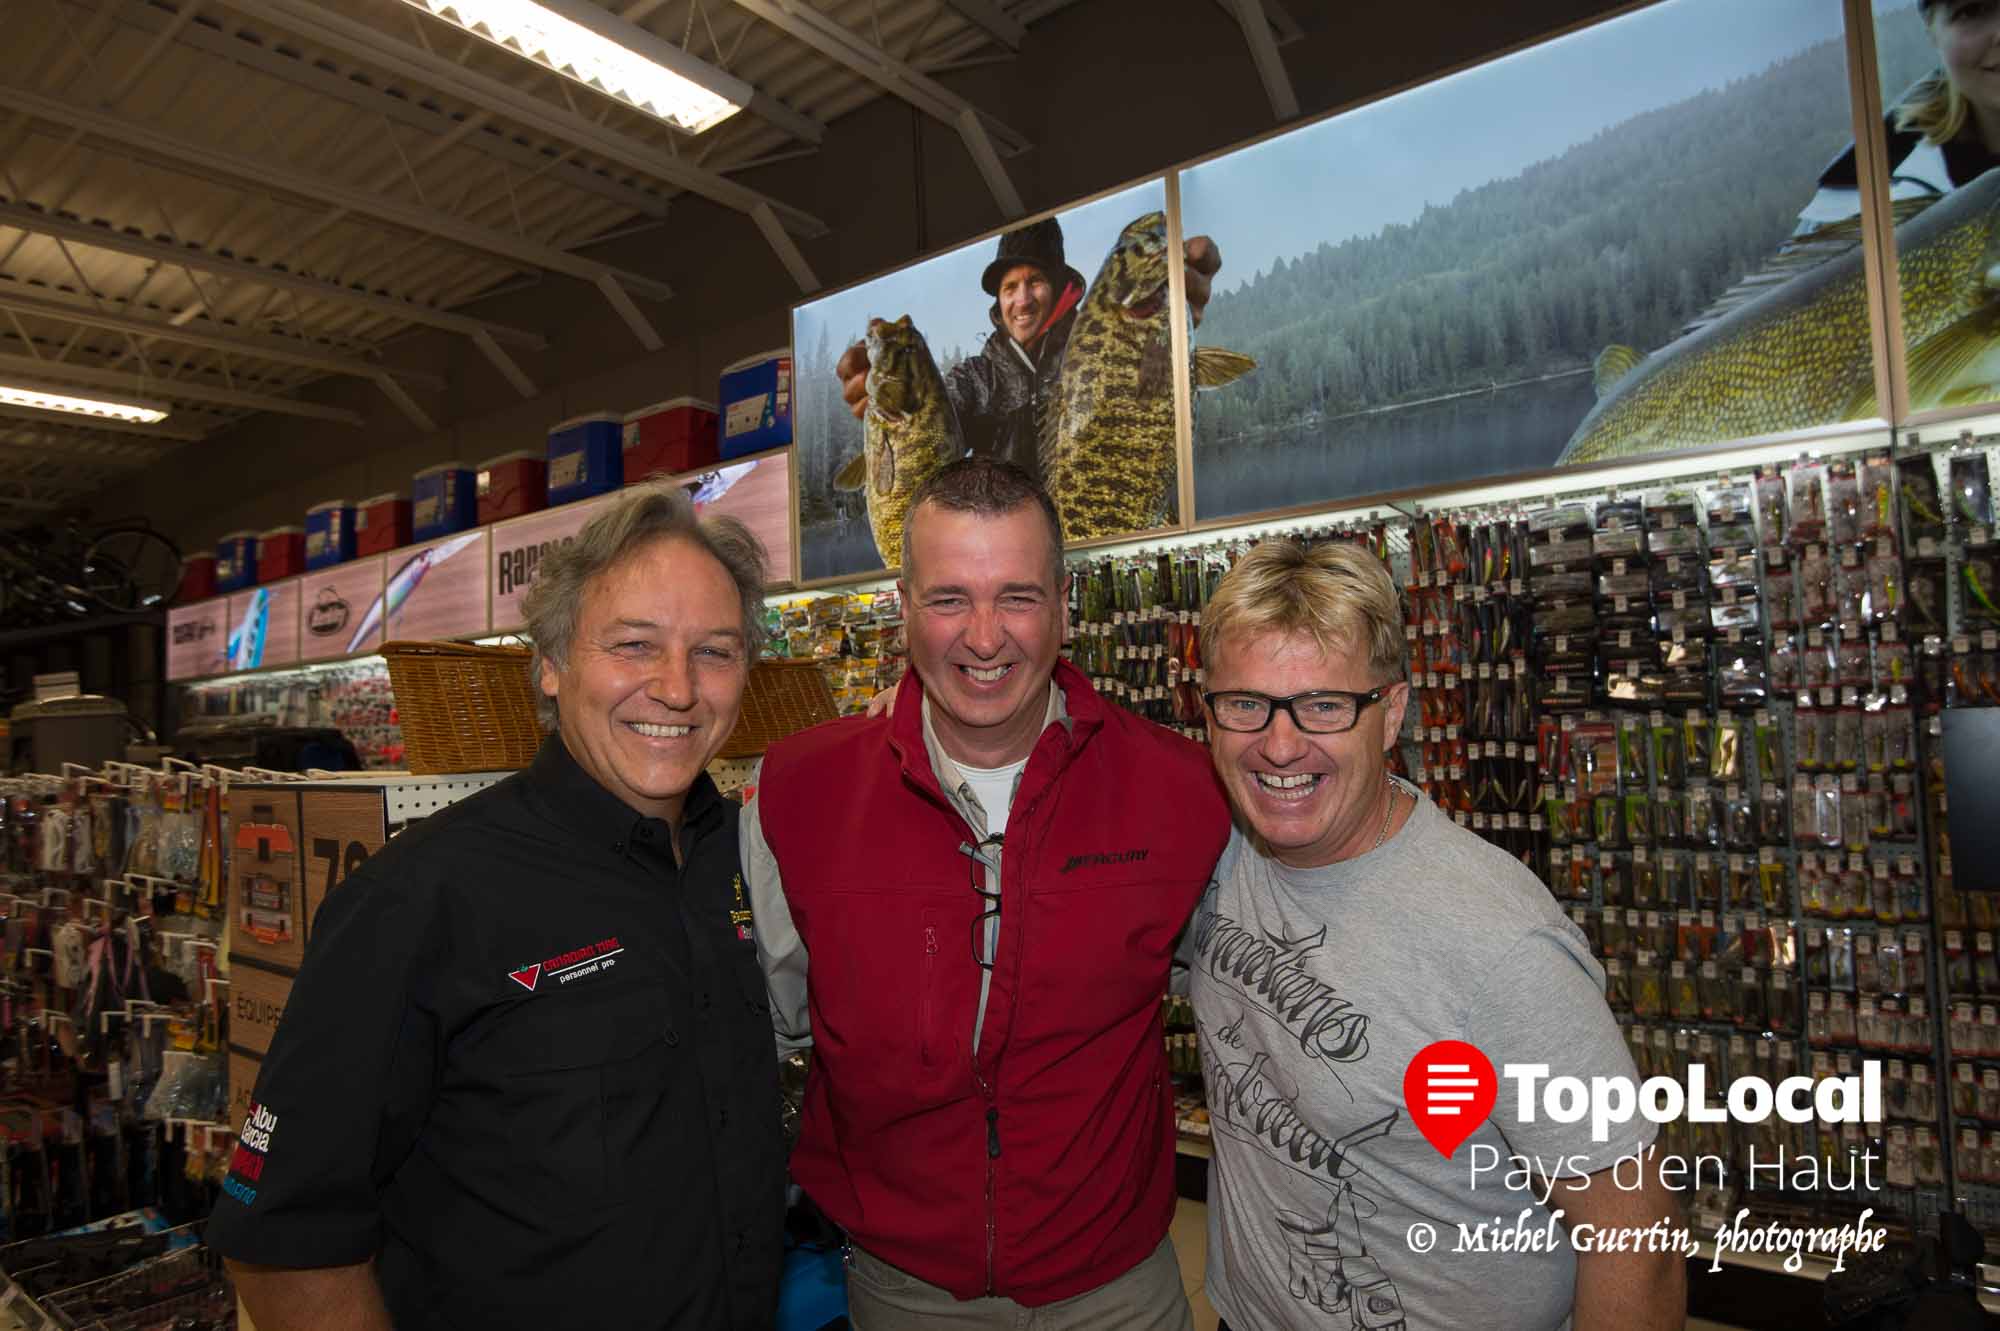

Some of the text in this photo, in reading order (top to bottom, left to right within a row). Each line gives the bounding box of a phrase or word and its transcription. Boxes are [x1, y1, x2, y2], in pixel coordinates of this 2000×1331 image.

[499, 535, 574, 595] Rap
[559, 958, 616, 984] personnel pro
[1212, 1013, 1244, 1049] de
[251, 1103, 278, 1133] Abu
